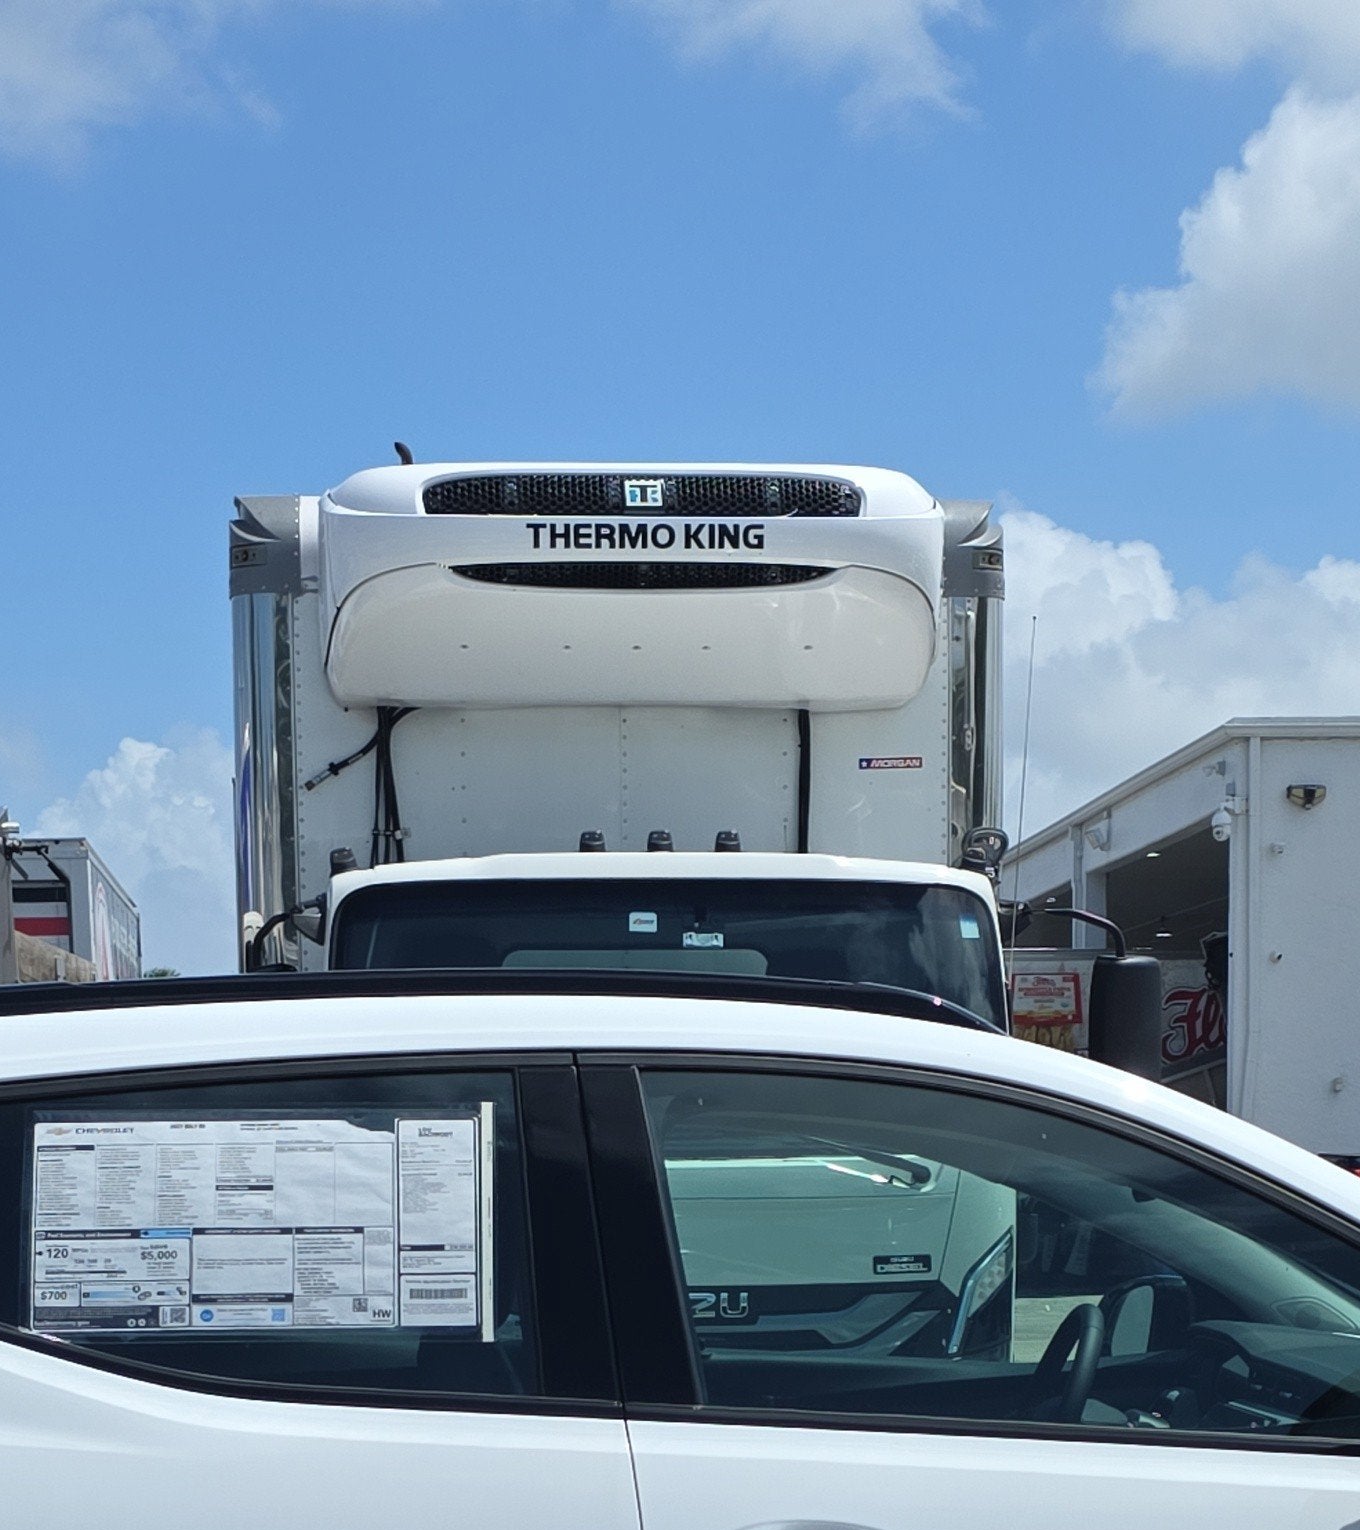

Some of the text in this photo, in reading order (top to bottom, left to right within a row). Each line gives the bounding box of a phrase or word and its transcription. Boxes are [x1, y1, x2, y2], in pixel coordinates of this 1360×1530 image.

[526, 523, 765, 549] THERMO KING
[870, 759, 920, 768] MORGAN
[75, 1127, 135, 1135] CHEVROLET
[46, 1248, 69, 1259] 120
[140, 1250, 178, 1261] $5,000
[40, 1291, 67, 1300] $700
[372, 1309, 391, 1319] HW
